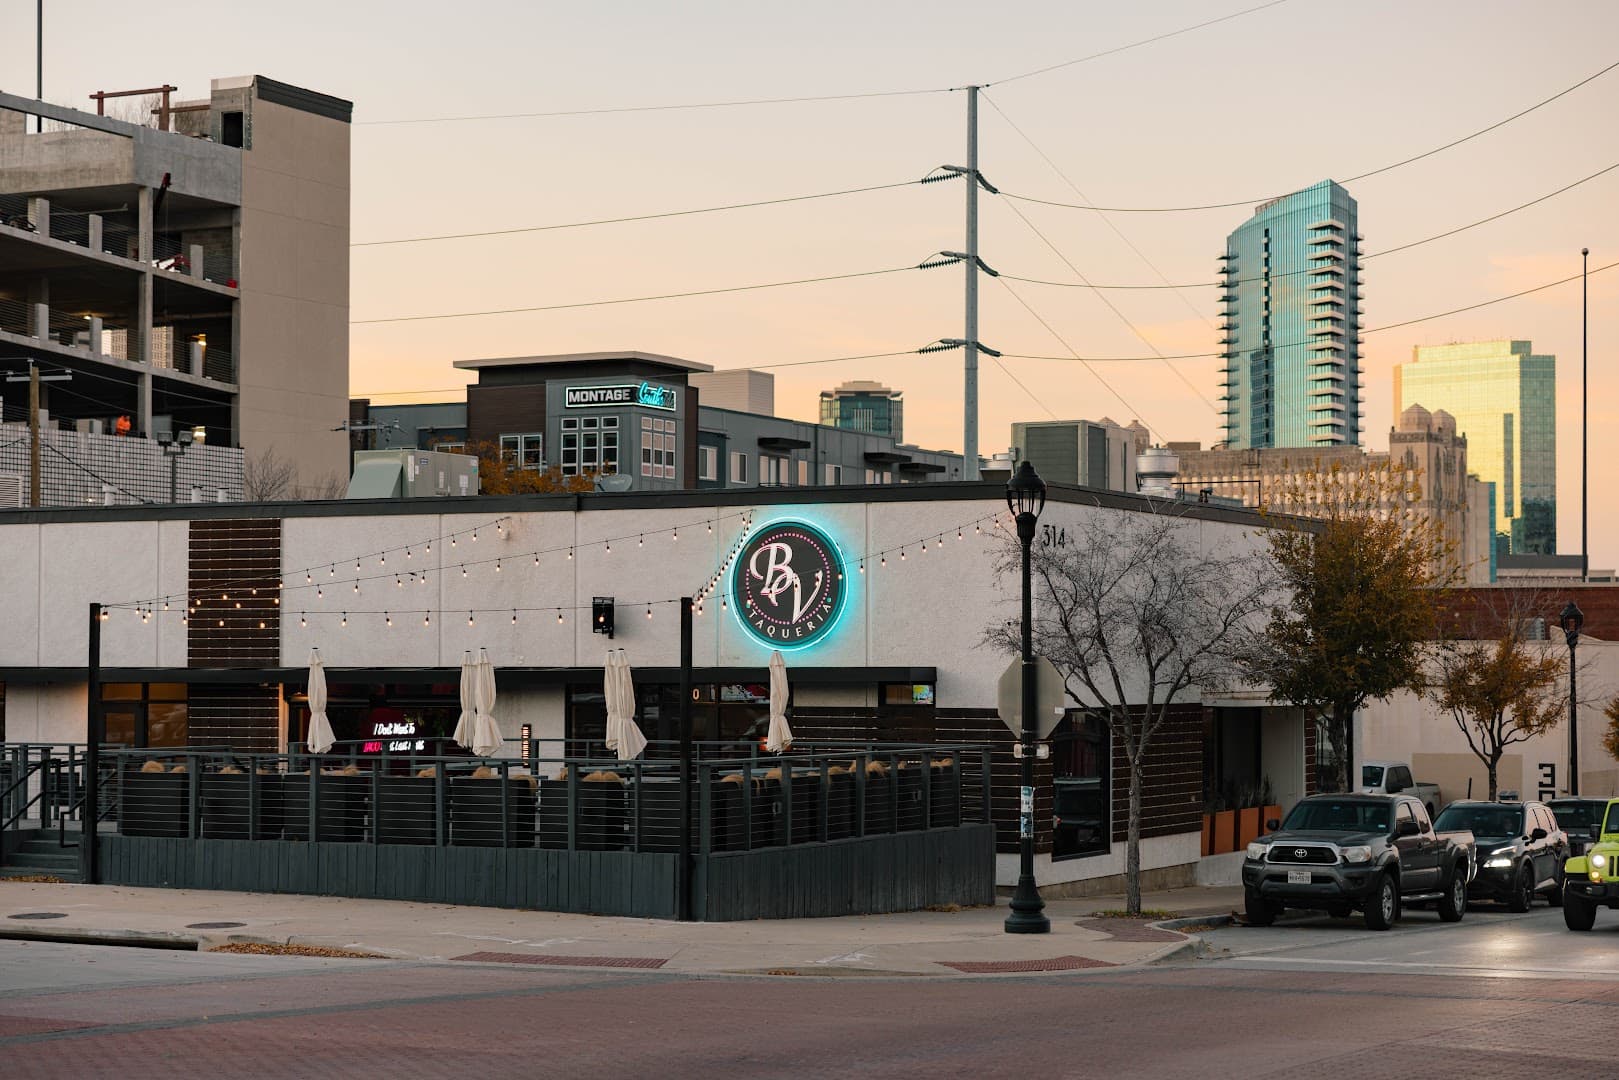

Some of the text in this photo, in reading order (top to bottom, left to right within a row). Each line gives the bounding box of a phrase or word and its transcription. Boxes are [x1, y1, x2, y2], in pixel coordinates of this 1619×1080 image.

[568, 389, 631, 403] MONTAGE
[1042, 525, 1066, 549] 314
[748, 603, 832, 638] TAQUERIA
